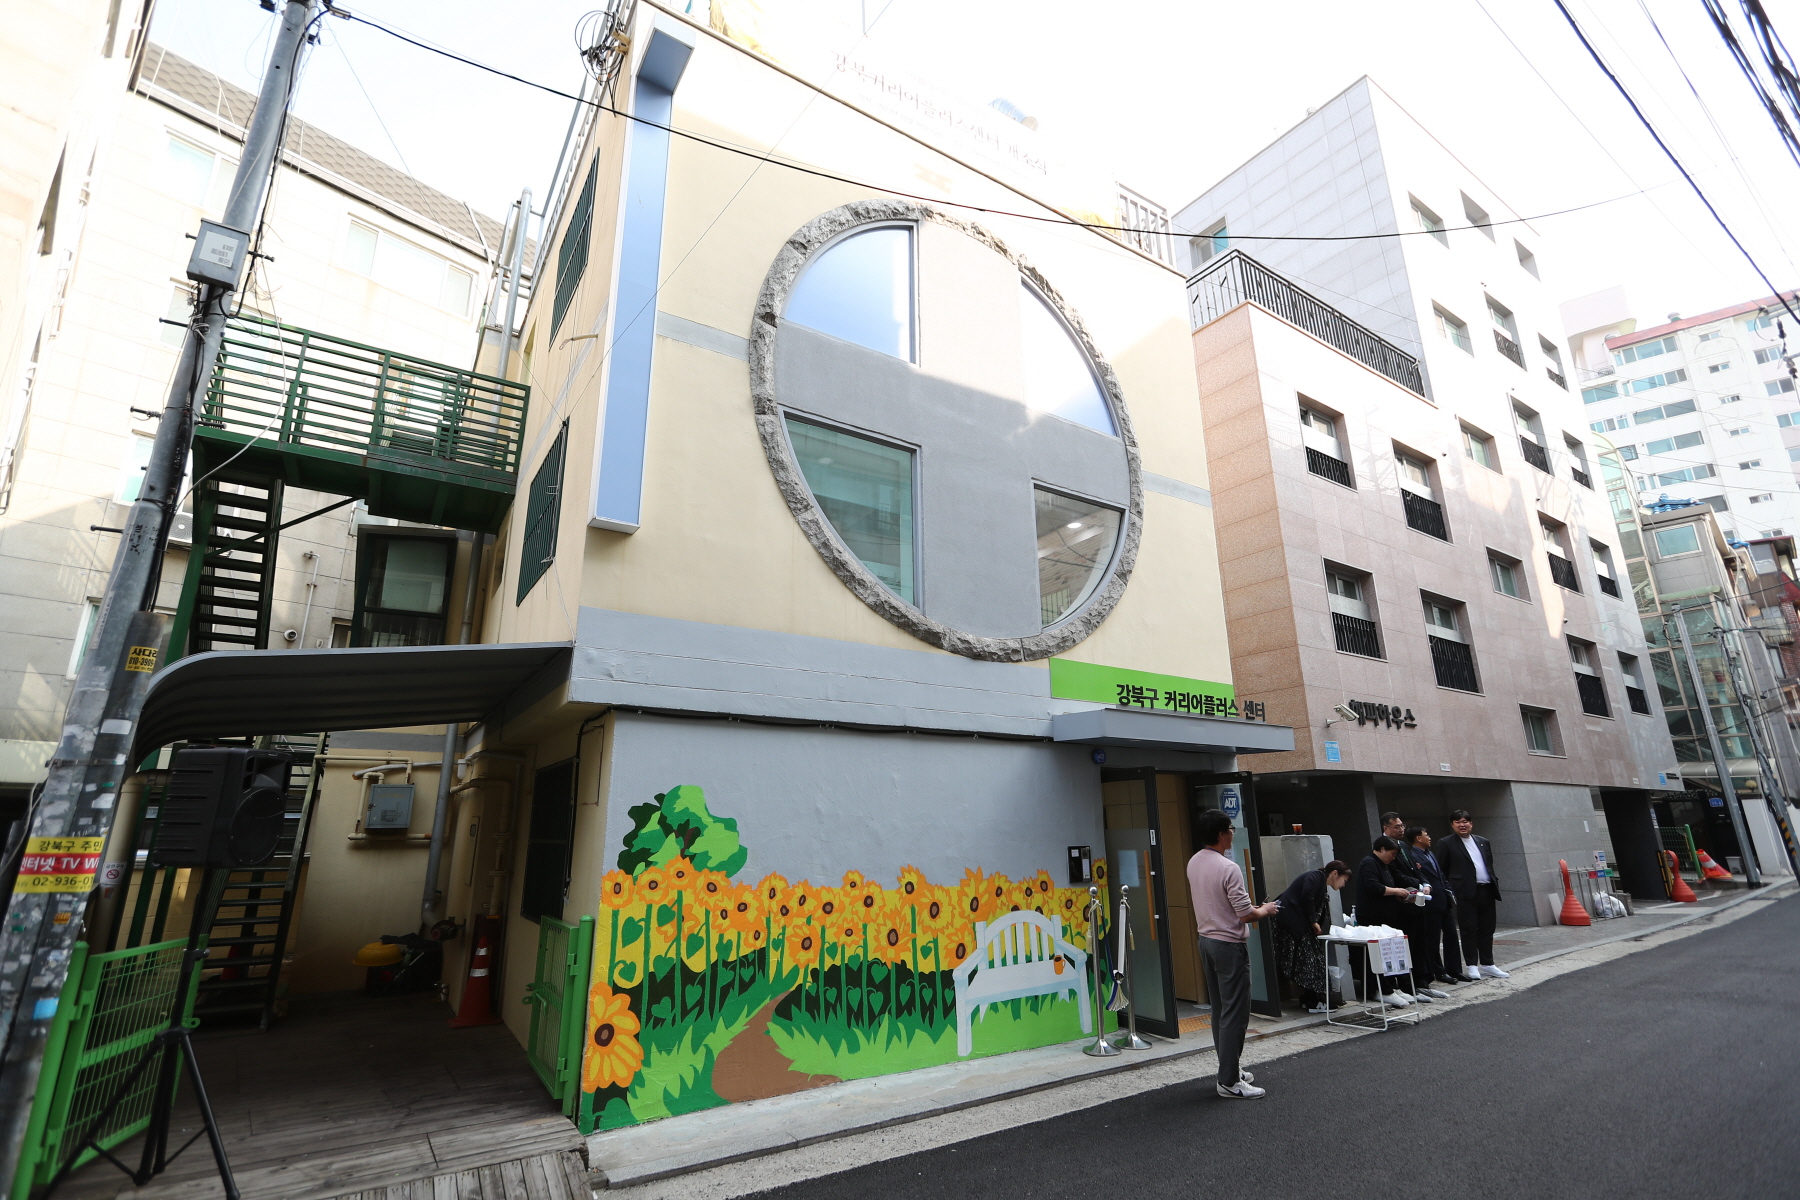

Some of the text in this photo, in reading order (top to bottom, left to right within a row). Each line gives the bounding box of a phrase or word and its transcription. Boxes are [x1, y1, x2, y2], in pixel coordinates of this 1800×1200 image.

[1116, 683, 1266, 722] 강북구 커리어플러스 센터
[1224, 797, 1237, 809] ADT
[39, 840, 76, 852] 강북구
[61, 857, 81, 869] TV
